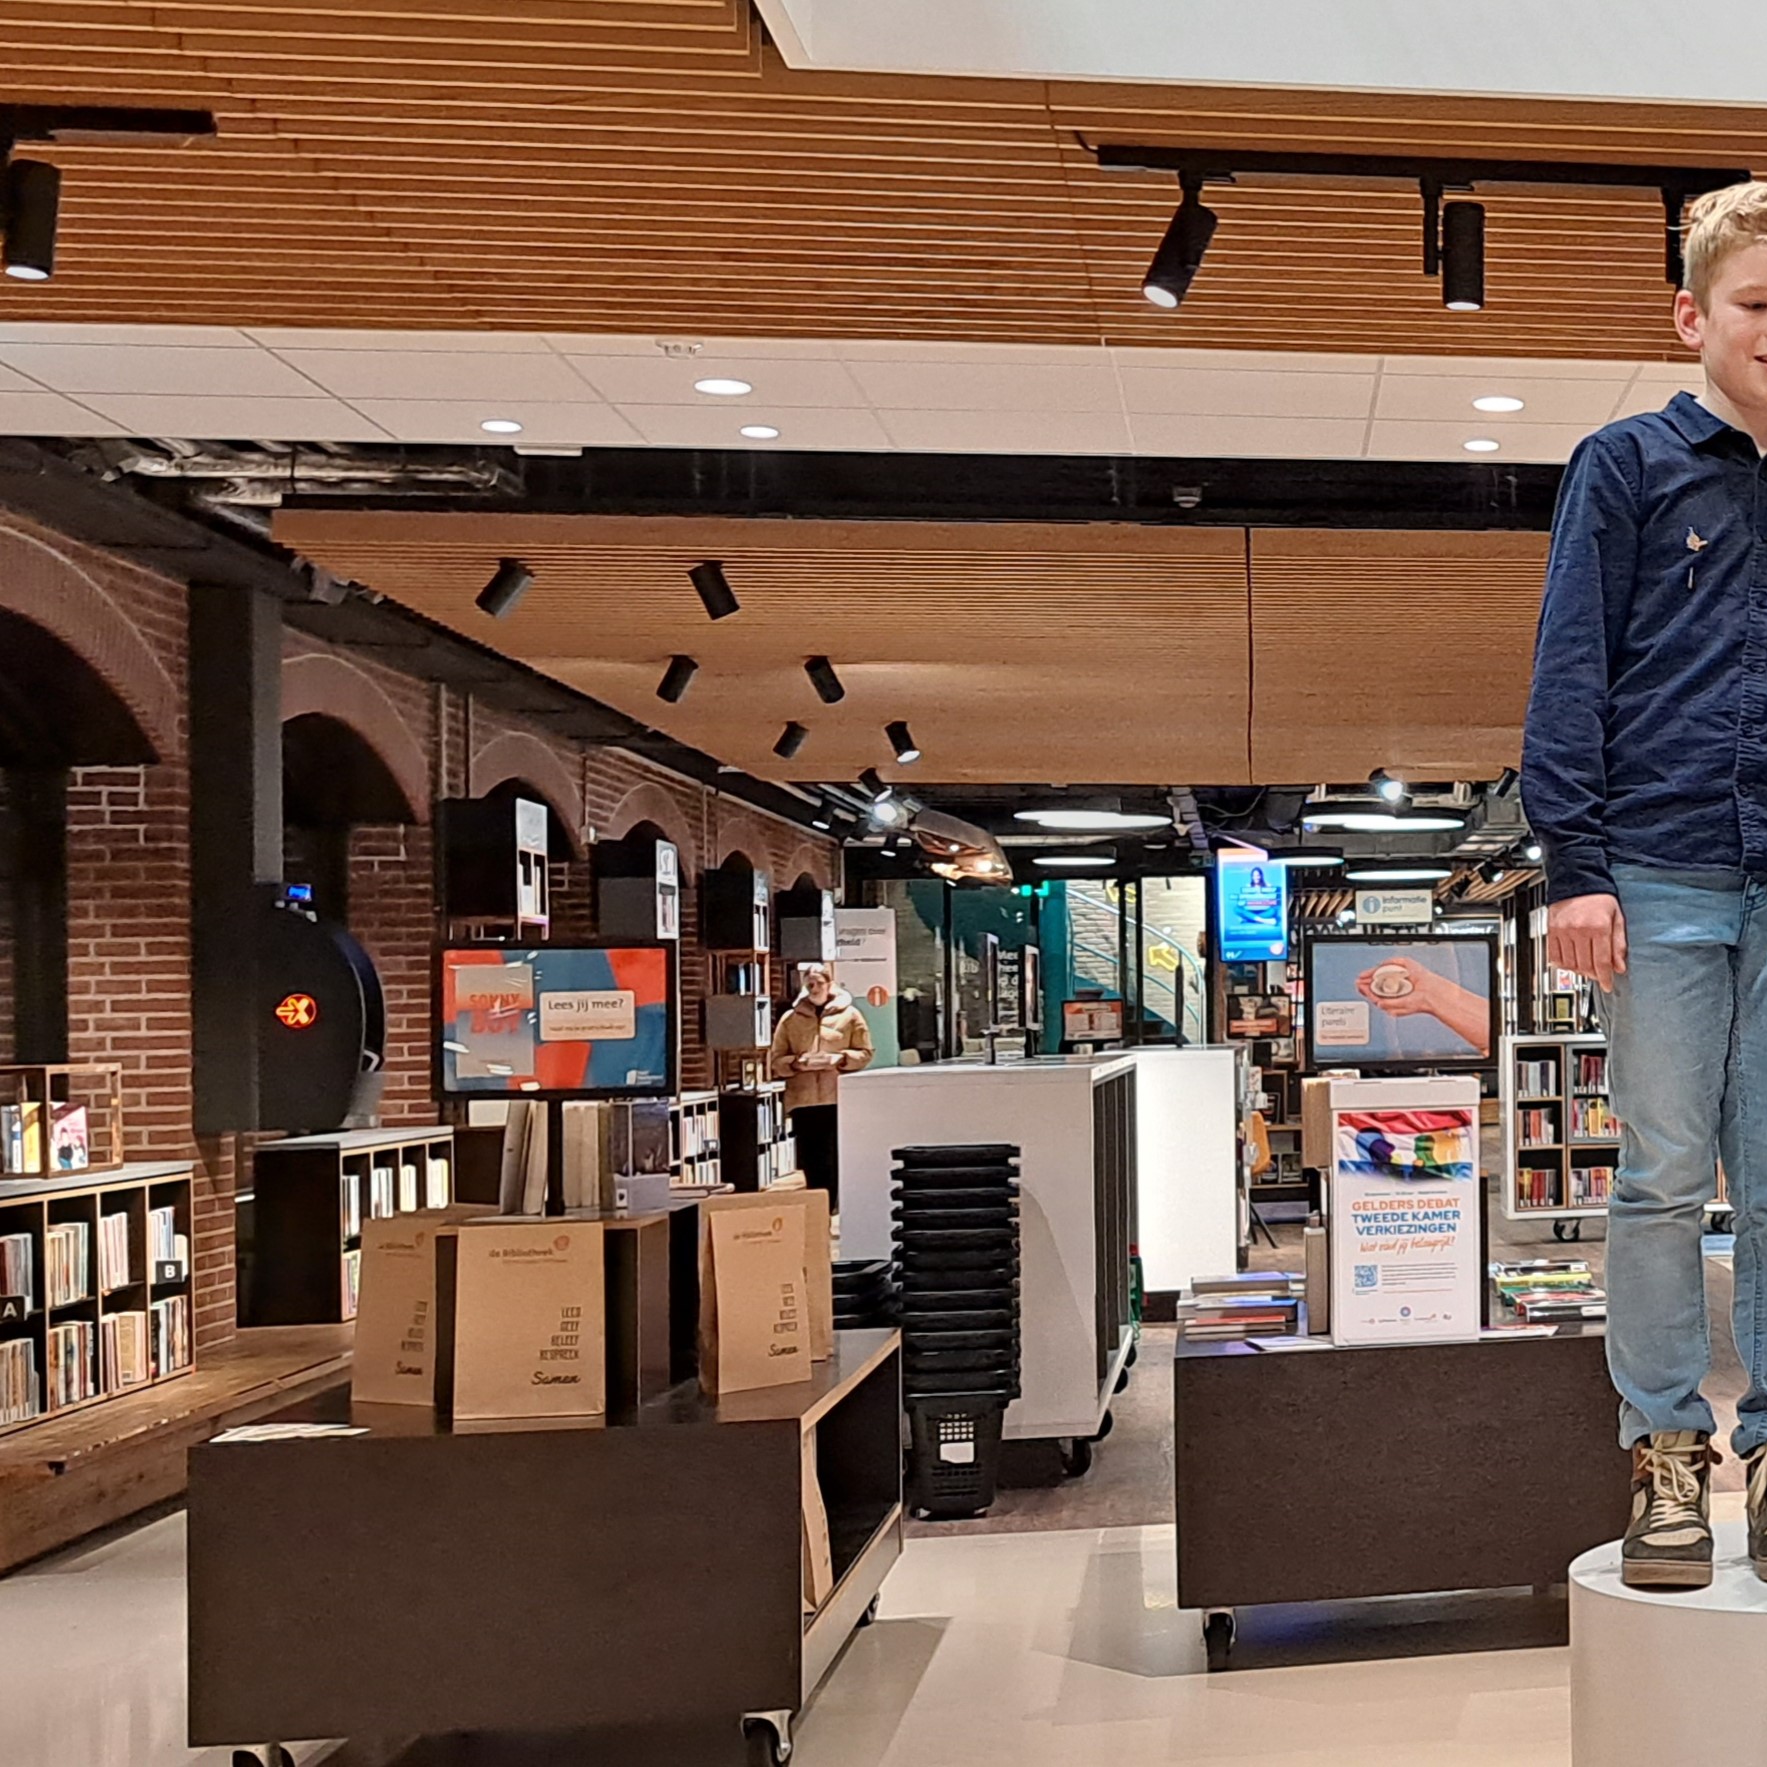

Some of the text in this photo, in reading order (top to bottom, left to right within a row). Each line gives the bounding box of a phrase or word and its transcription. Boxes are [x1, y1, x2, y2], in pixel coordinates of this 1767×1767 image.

[548, 998, 624, 1014] Lees jij mee?
[1352, 1198, 1460, 1211] GELDERS DEBAT
[1352, 1211, 1460, 1223] TWEEDE KAMER
[1356, 1223, 1456, 1236] VERKIEZINGEN
[164, 1265, 176, 1279] B
[4, 1302, 17, 1317] A
[531, 1371, 581, 1385] Samen
